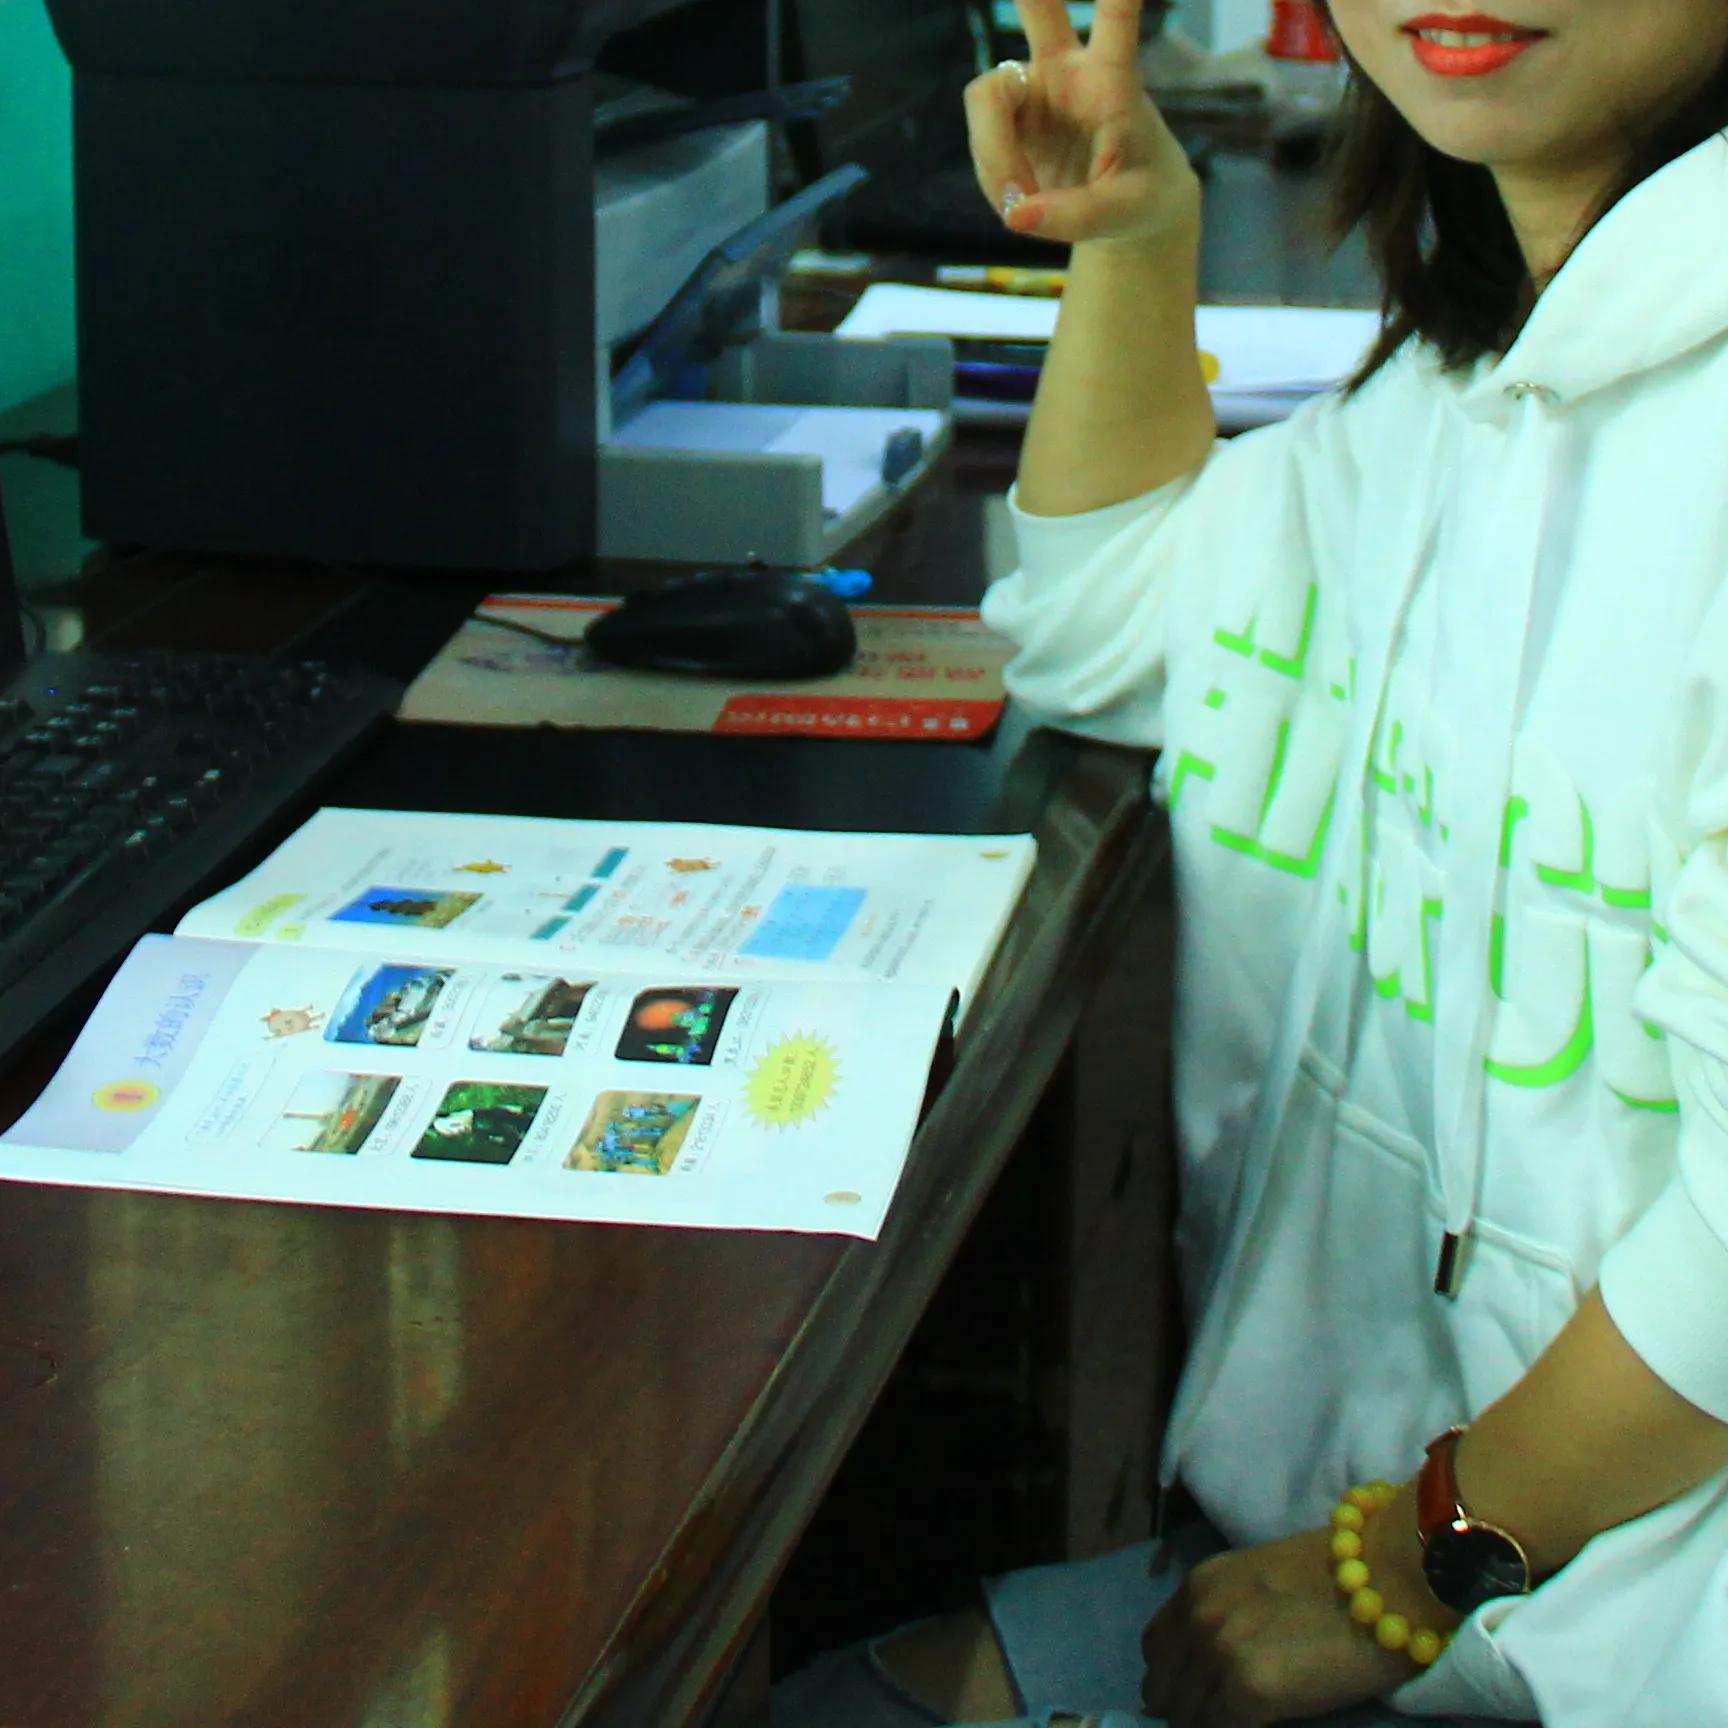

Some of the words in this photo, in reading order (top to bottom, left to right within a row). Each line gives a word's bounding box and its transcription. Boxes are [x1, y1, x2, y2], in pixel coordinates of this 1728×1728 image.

[131, 971, 215, 1070] 大数的认识
